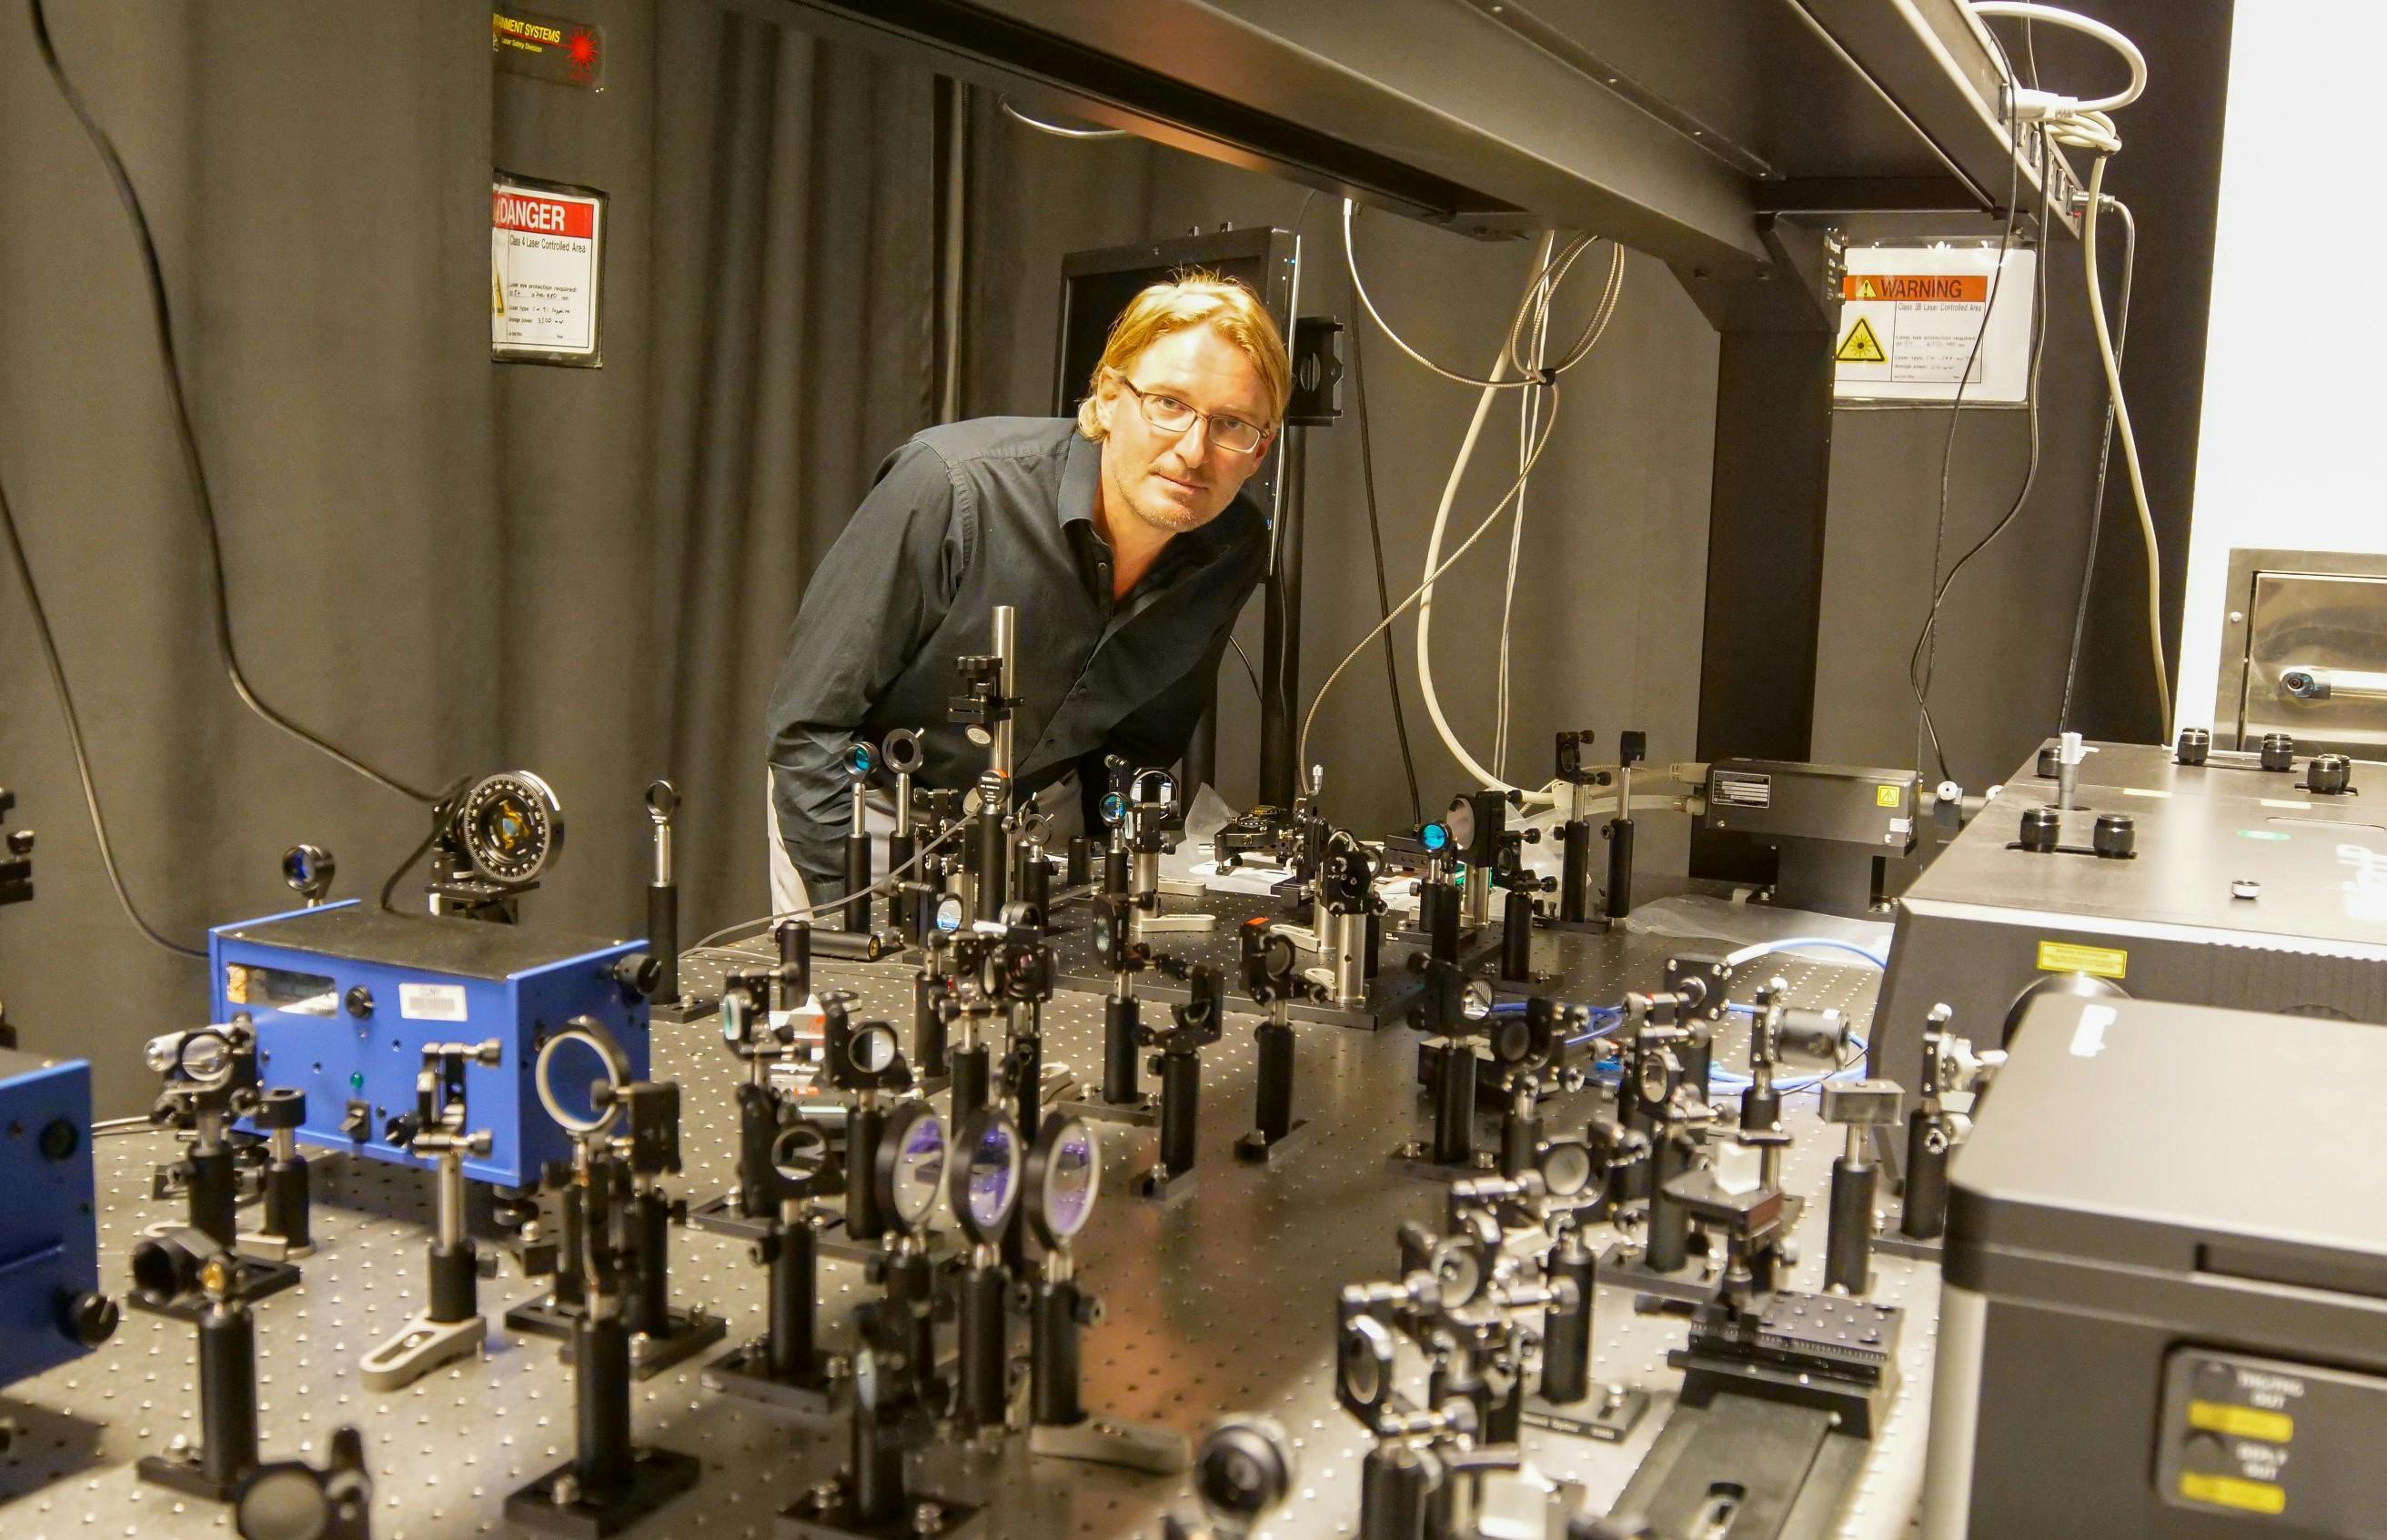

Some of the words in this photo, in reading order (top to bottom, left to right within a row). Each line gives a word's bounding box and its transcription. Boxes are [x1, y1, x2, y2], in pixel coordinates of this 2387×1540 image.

[525, 23, 561, 43] SYSTEMS
[500, 197, 565, 232] DANGER
[509, 235, 521, 247] Class
[526, 237, 540, 248] Laser
[541, 238, 570, 252] Controlled
[571, 242, 586, 254] Area
[1880, 279, 1962, 298] WARNING
[1940, 303, 1969, 312] Controlled
[1969, 303, 1982, 312] Area
